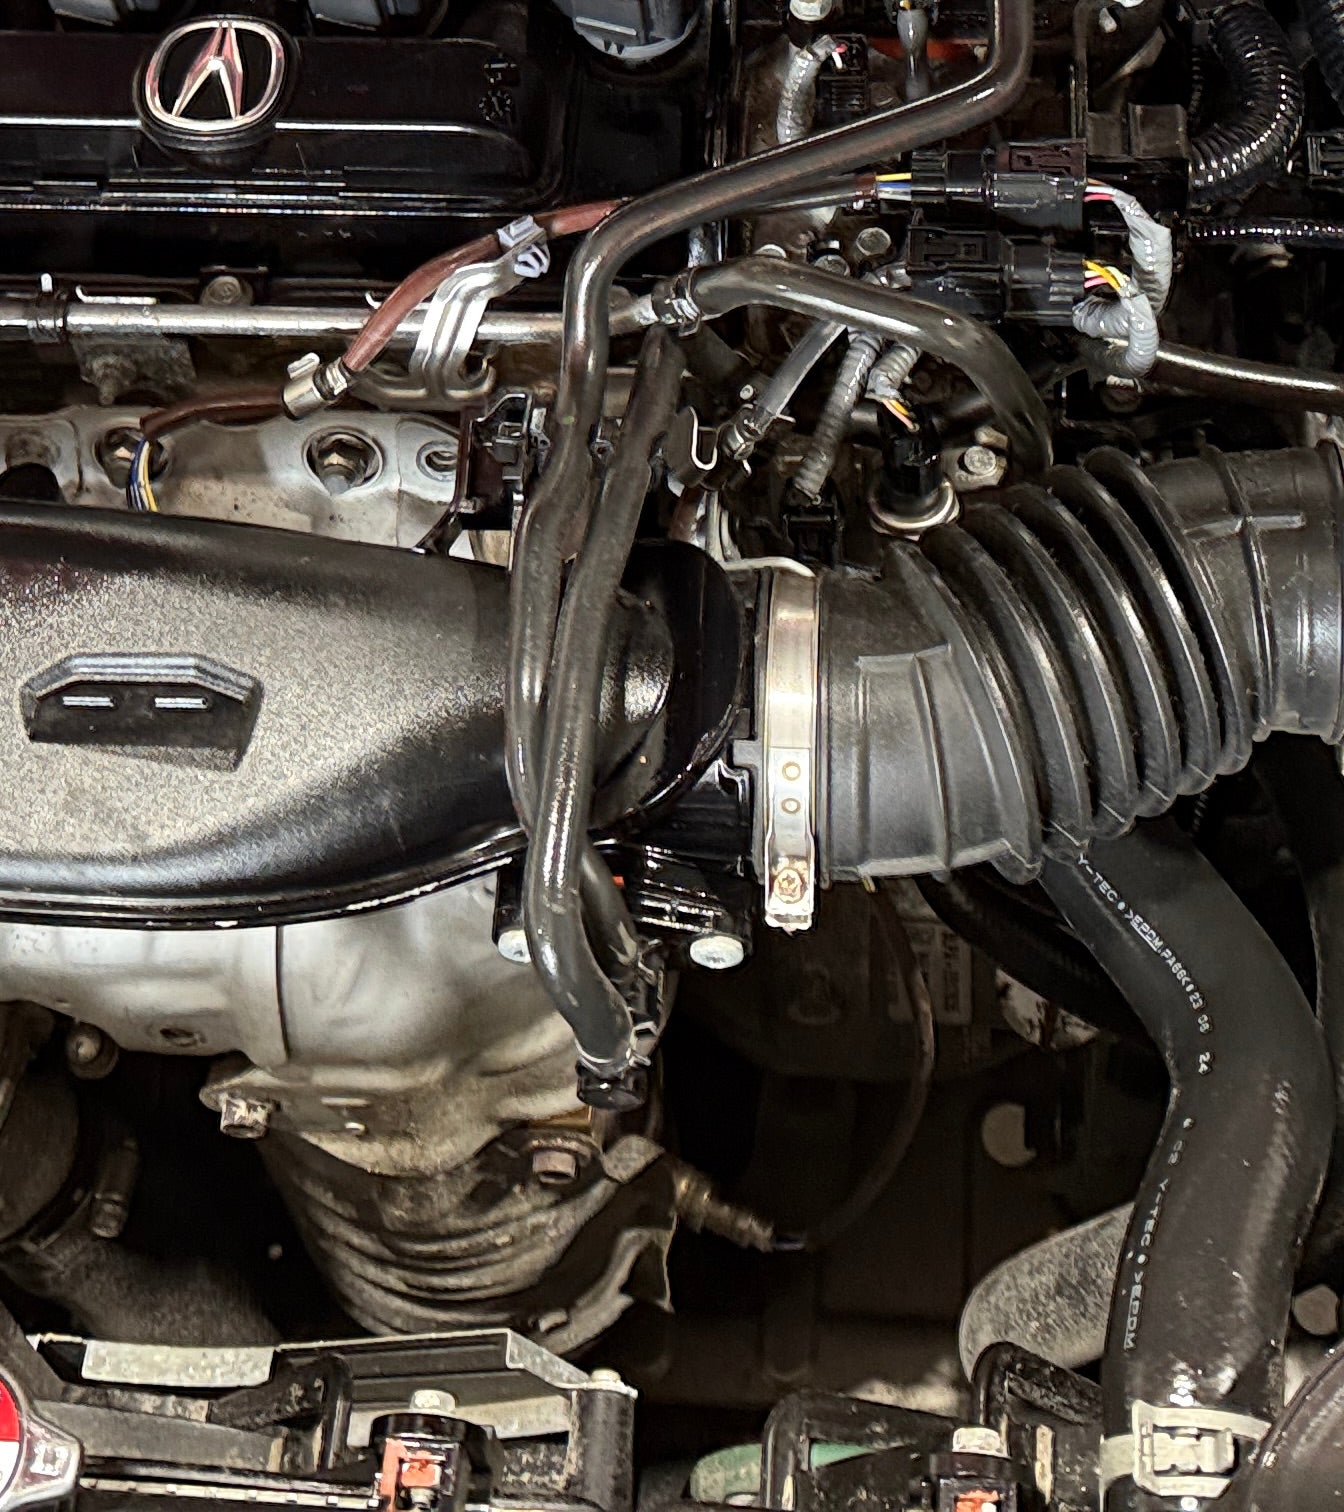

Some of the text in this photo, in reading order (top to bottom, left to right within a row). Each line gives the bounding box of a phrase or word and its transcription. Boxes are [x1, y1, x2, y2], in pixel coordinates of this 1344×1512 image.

[1077, 852, 1119, 903] Y-TEC
[1188, 991, 1204, 1011] 23
[1198, 1051, 1213, 1075] 24
[1140, 1177, 1170, 1248] Y-TEC
